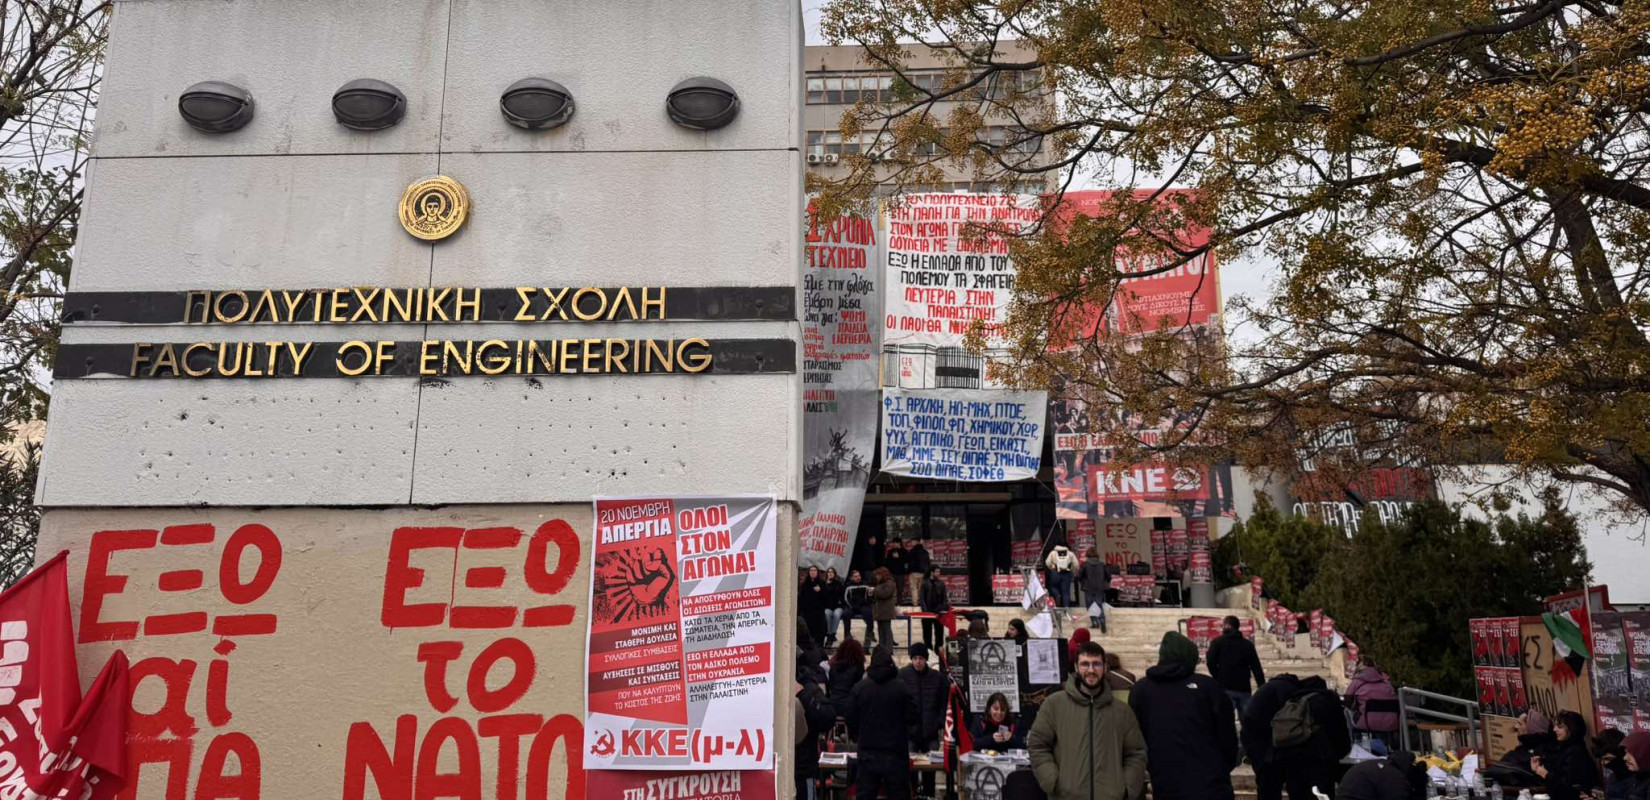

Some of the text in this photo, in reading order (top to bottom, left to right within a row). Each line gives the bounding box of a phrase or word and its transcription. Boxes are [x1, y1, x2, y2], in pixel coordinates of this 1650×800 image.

[914, 207, 942, 220] ΠΑΛΗ
[946, 206, 960, 219] ΓΙΑ
[966, 206, 986, 220] ΤΗΝ
[890, 222, 913, 237] ΣΤΟΝ
[917, 222, 948, 237] ΑΓΩΝΑ
[889, 236, 929, 252] ΔΟΥΛΕΙΑ
[933, 238, 948, 252] ΜΕ
[888, 252, 1009, 271] ΕΞΩ Η ΕΛΛΑΔΑ ΑΠΟ ΤΟΥ
[901, 271, 1014, 289] ΠΟΛΕΜΟΥ ΤΑ ΣΦΑΓΕΙΑ
[905, 287, 995, 306] ΛΕΥΤΕΡΙΑ ΣΤΗΝ
[184, 285, 667, 326] ΠΟΛΥΤΕΧΝΙΚΗ ΣΧΟΛΗ
[928, 305, 996, 320] ΠΑΛΑΙΣΤΙΝΗ!
[886, 315, 897, 329] ΟΙ
[927, 319, 942, 332] ΘΑ
[130, 336, 713, 379] FACULTY OF ENGINEERING
[1096, 468, 1167, 495] ΚΝΕ
[602, 501, 671, 524] 20 ΝΟΕΜΒΡΗ
[679, 505, 728, 531] ΟΛΟΙ
[602, 517, 673, 545] ΑΠΕΡΓΙΑ
[1106, 523, 1137, 539] ΕΞΩ
[681, 530, 731, 556] ΣΤΟΝ
[683, 550, 756, 582] ΑΓΩΝΑ!
[78, 523, 283, 644] ΕΞΩ
[381, 519, 580, 633] ΕΞΩ
[683, 589, 761, 606] ΝΑ ΑΠΟΣΥΡΘΟΥΝ ΟΛΕΣ
[694, 604, 722, 614] ΔΙΩΞΕΙΣ
[724, 598, 766, 610] ΑΓΩΝΙΣΤΩΝ!
[684, 617, 702, 626] ΚΑΤΩ
[714, 613, 734, 622] ΧΕΡΙΑ
[736, 612, 750, 620] ΑΠΟ
[752, 610, 760, 618] ΤΑ
[722, 622, 735, 630] ΤΗΝ
[738, 619, 768, 628] ΑΠΕΡΓΙΑ,
[631, 622, 676, 637] ΜΟΝΙΜΗ ΚΑΙ
[697, 631, 735, 642] ΔΙΑΔΗΛΩΣΗ
[615, 632, 677, 649] ΣΤΑΘΕΡΗ ΔΟΥΛΕΙΑ
[604, 644, 678, 663] ΣΥΛΛΟΓΙΚΕΣ ΣΥΜΒΑΣΕΙΣ
[687, 653, 700, 661] ΕΞΩ
[709, 648, 738, 658] ΕΛΛΑΔΑ
[740, 645, 755, 654] ΑΠΟ
[603, 661, 679, 680] ΑΥΞΗΣΕΙΣ ΣΕ ΜΙΣΘΟΥΣ
[688, 655, 760, 671] ΤΟΝ ΑΔΙΚΟ ΠΟΛΕΜΟ
[628, 672, 680, 686] ΚΑΙ ΣΥΝΤΑΞΕΙΣ
[688, 667, 745, 682] ΣΤΗΝ ΟΥΚΡΑΝΙΑ
[127, 640, 237, 737] αί
[618, 684, 681, 700] ΠΟΥ ΝΑ ΚΑΛΥΠΤΟΥΝ
[690, 688, 748, 702] ΣΤΗΝ ΠΑΛΑΙΣΤΙΝΗ
[614, 693, 681, 710] ΤΟ ΚΟΣΤΟΣ ΤΗΣ ΖΩΗΣ
[343, 713, 588, 800] ΝΑΤΟ
[120, 732, 261, 800] ΠΑ
[646, 771, 741, 800] ΣΥΓΚΡΟΥΣΗ
